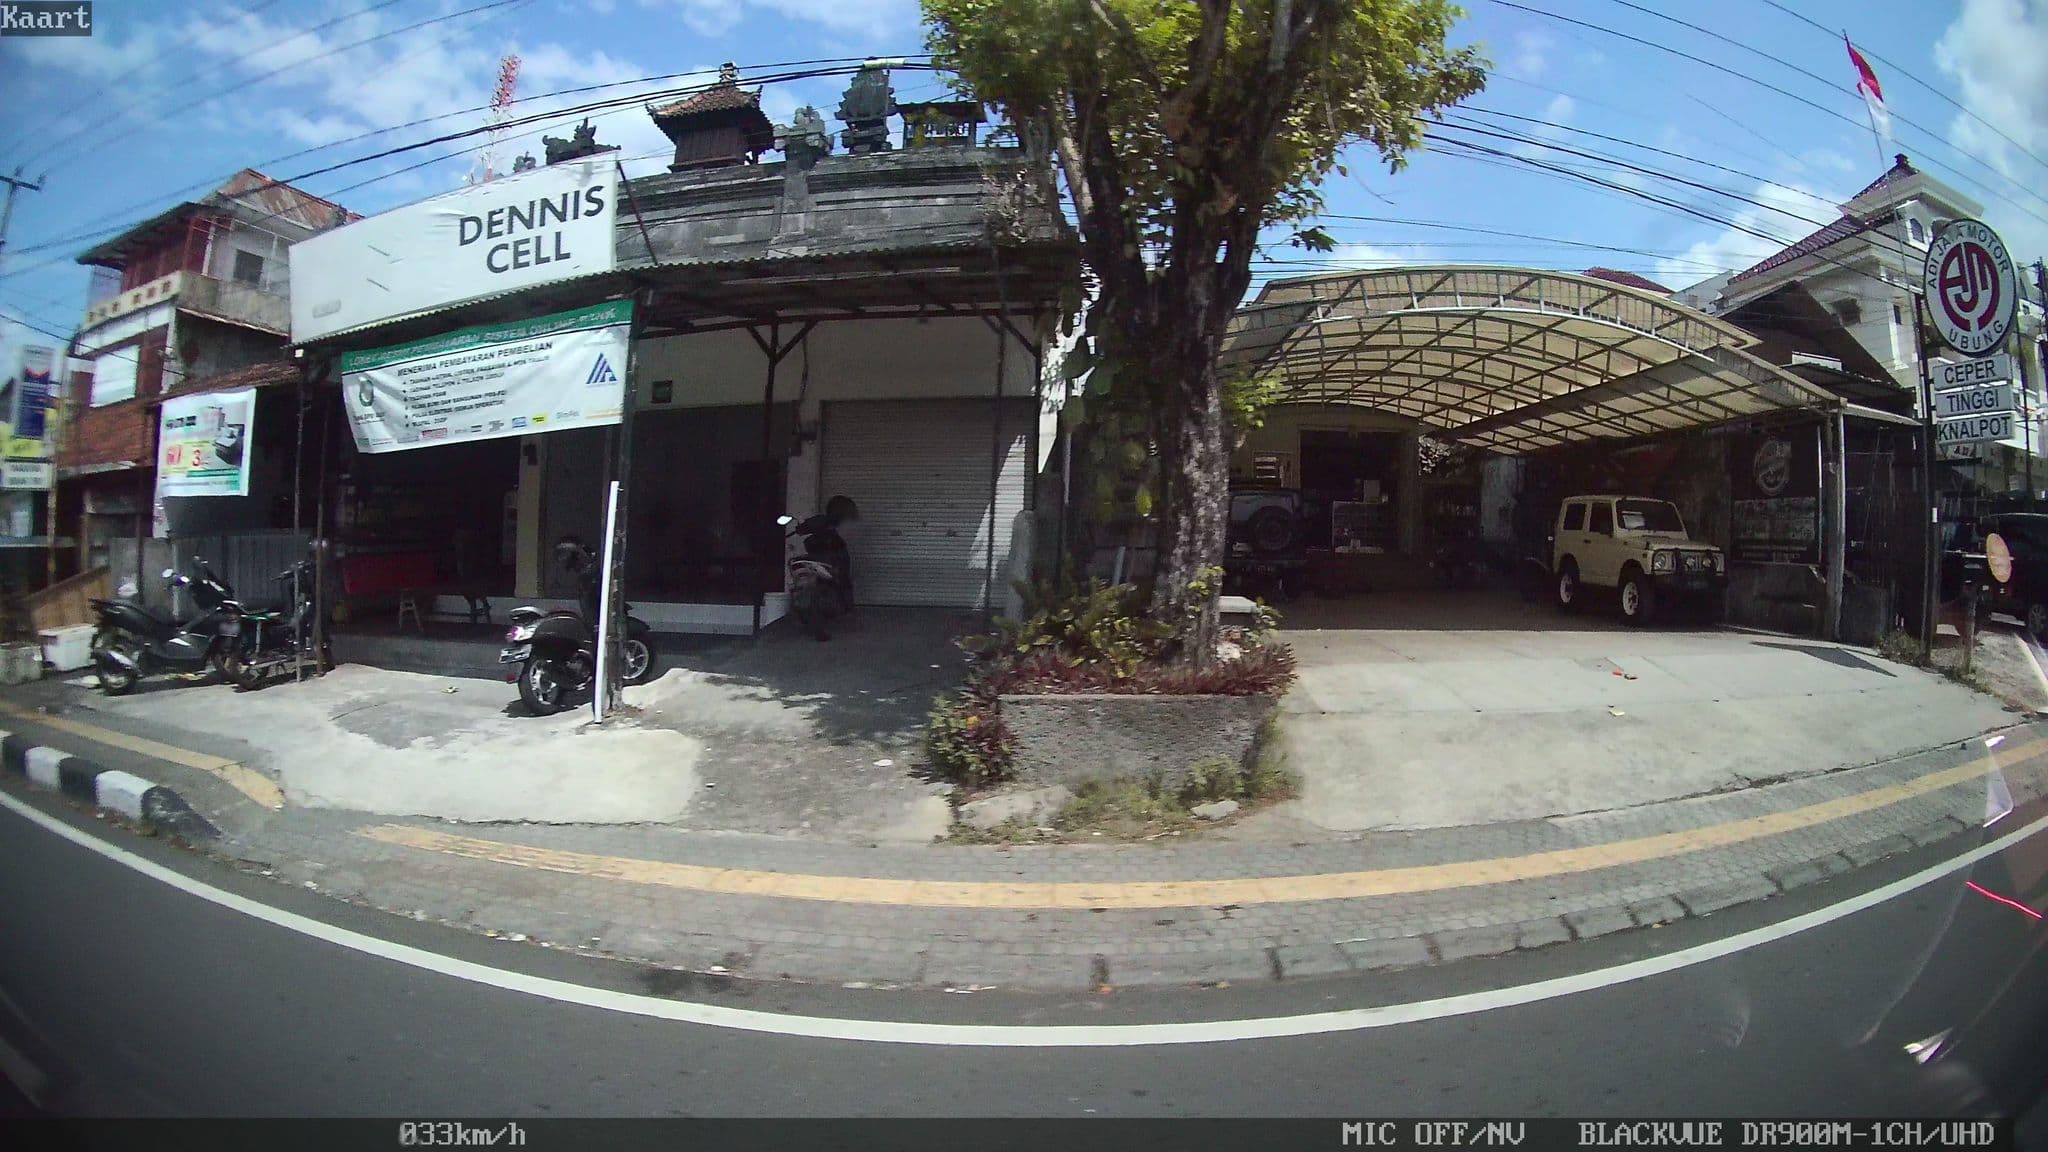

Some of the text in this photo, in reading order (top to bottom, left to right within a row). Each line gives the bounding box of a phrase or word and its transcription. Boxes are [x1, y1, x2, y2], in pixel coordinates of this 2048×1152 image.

[459, 185, 604, 246] DENNIS
[487, 231, 571, 274] CELL
[1928, 258, 1940, 289] ADI
[1967, 223, 2008, 274] MOTOR
[1949, 319, 2003, 350] UBUNG
[440, 351, 495, 368] PEMBAYARAN
[498, 342, 552, 357] PEMBELIAN
[1944, 359, 1996, 384] CEPER
[1946, 389, 1999, 412] TINGGI
[1938, 416, 2011, 441] KNALPOT
